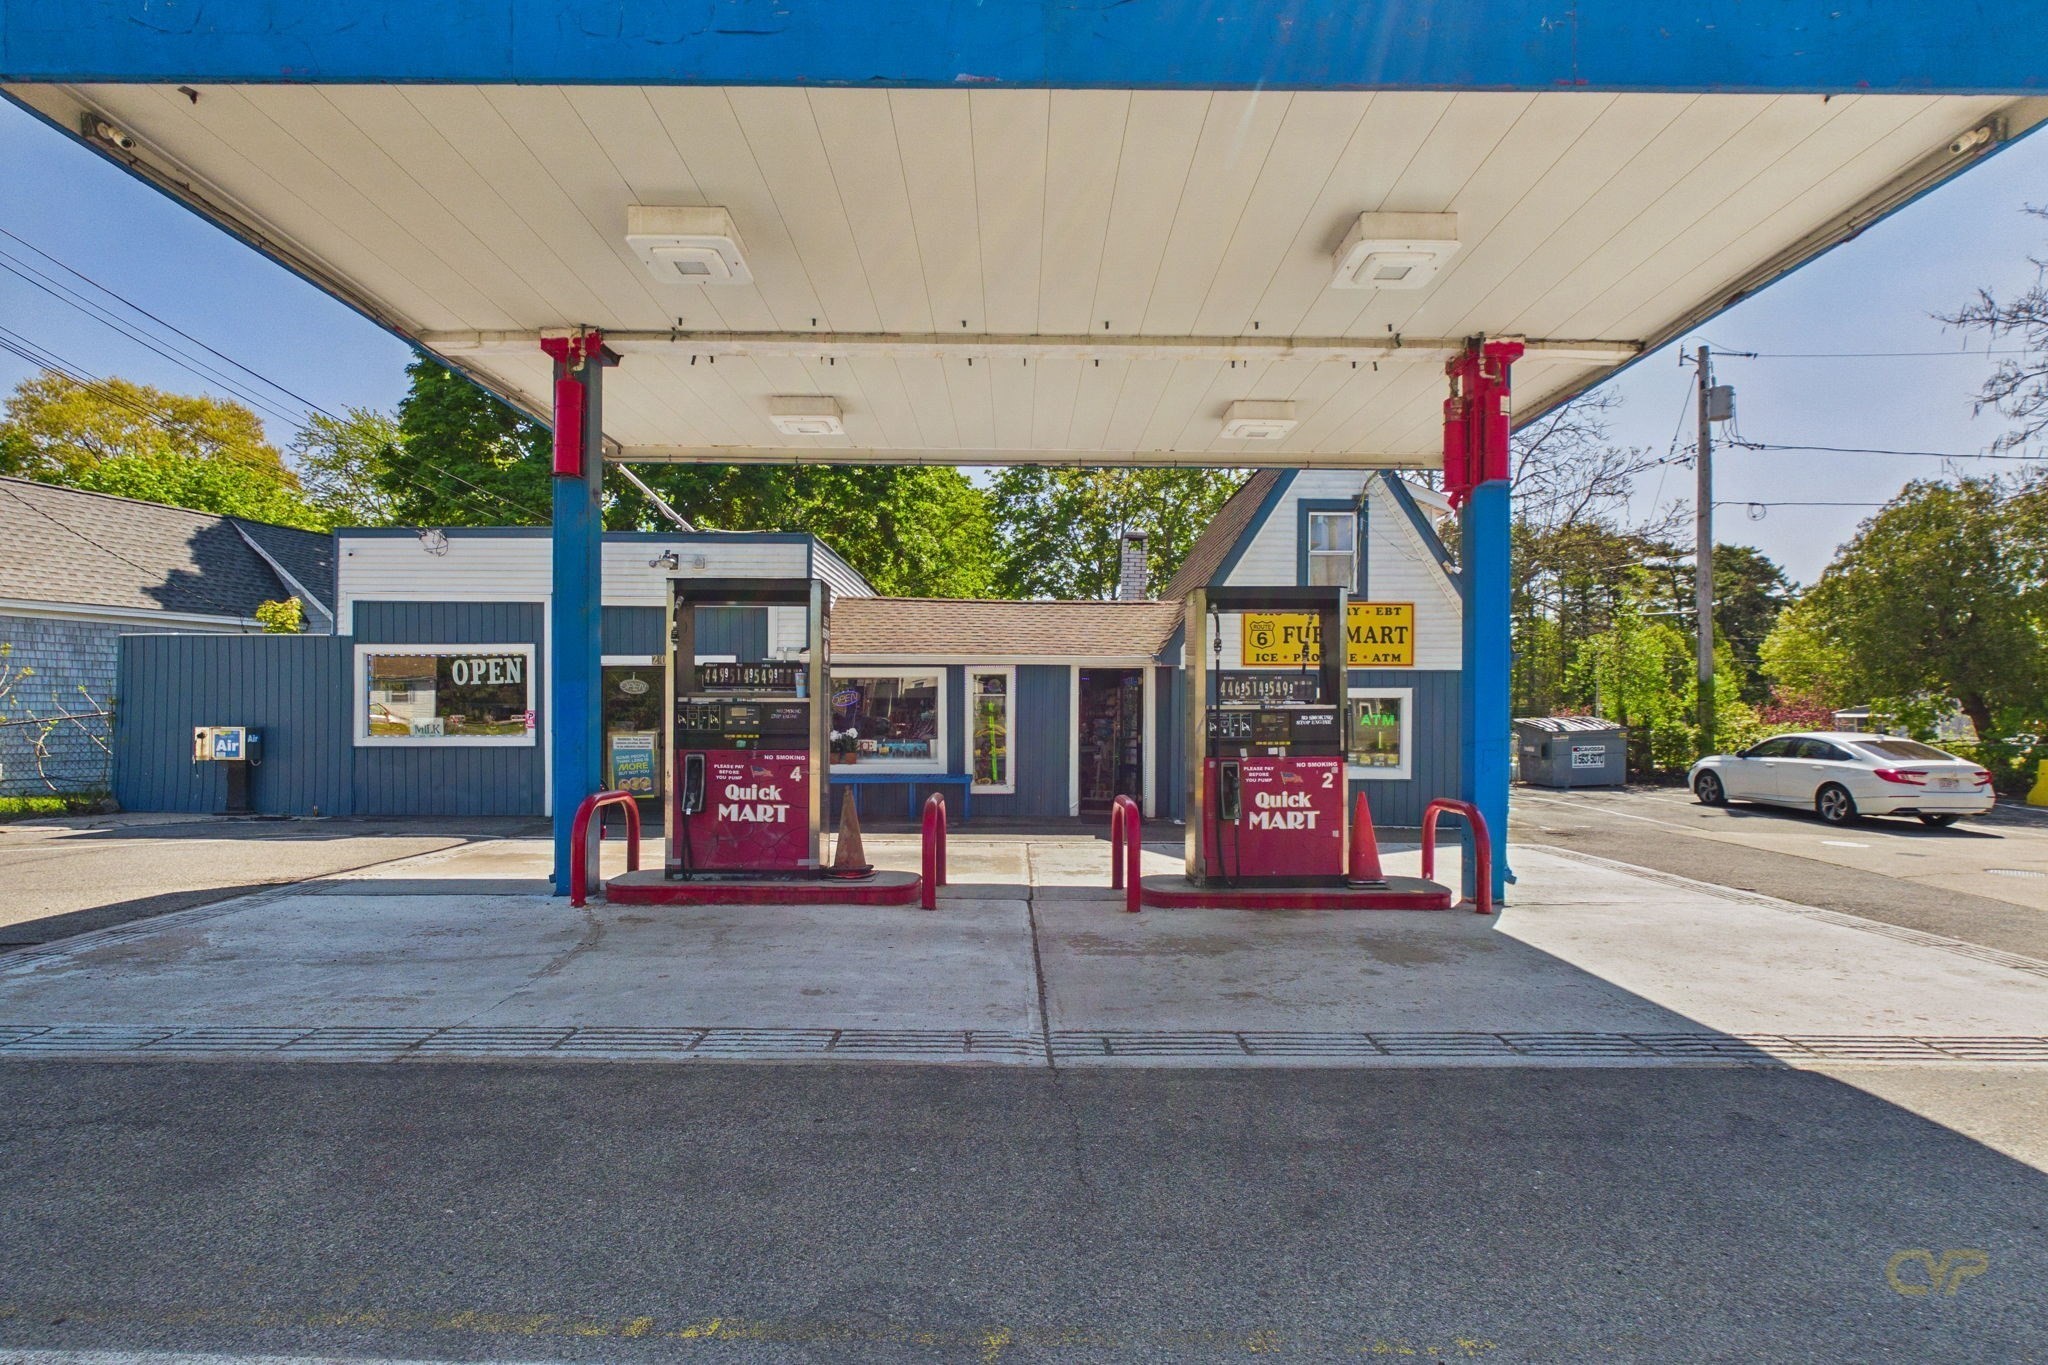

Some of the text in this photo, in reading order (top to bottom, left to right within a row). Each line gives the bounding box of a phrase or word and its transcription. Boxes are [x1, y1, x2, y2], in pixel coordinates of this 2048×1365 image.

[1376, 607, 1402, 616] EBT
[1256, 632, 1268, 645] 6
[1283, 626, 1323, 644] FUE
[1255, 653, 1279, 662] ICE
[1372, 653, 1401, 662] ATM
[452, 657, 522, 686] OPEN
[1360, 714, 1395, 726] ATM
[215, 739, 239, 751] Air
[247, 734, 259, 743] Air
[618, 761, 649, 771] MORE
[789, 766, 802, 782] 4
[1321, 772, 1334, 788] 2
[725, 783, 783, 801] Quick
[1255, 790, 1312, 809] Quick
[718, 803, 790, 823] MART
[1249, 810, 1320, 830] MART
